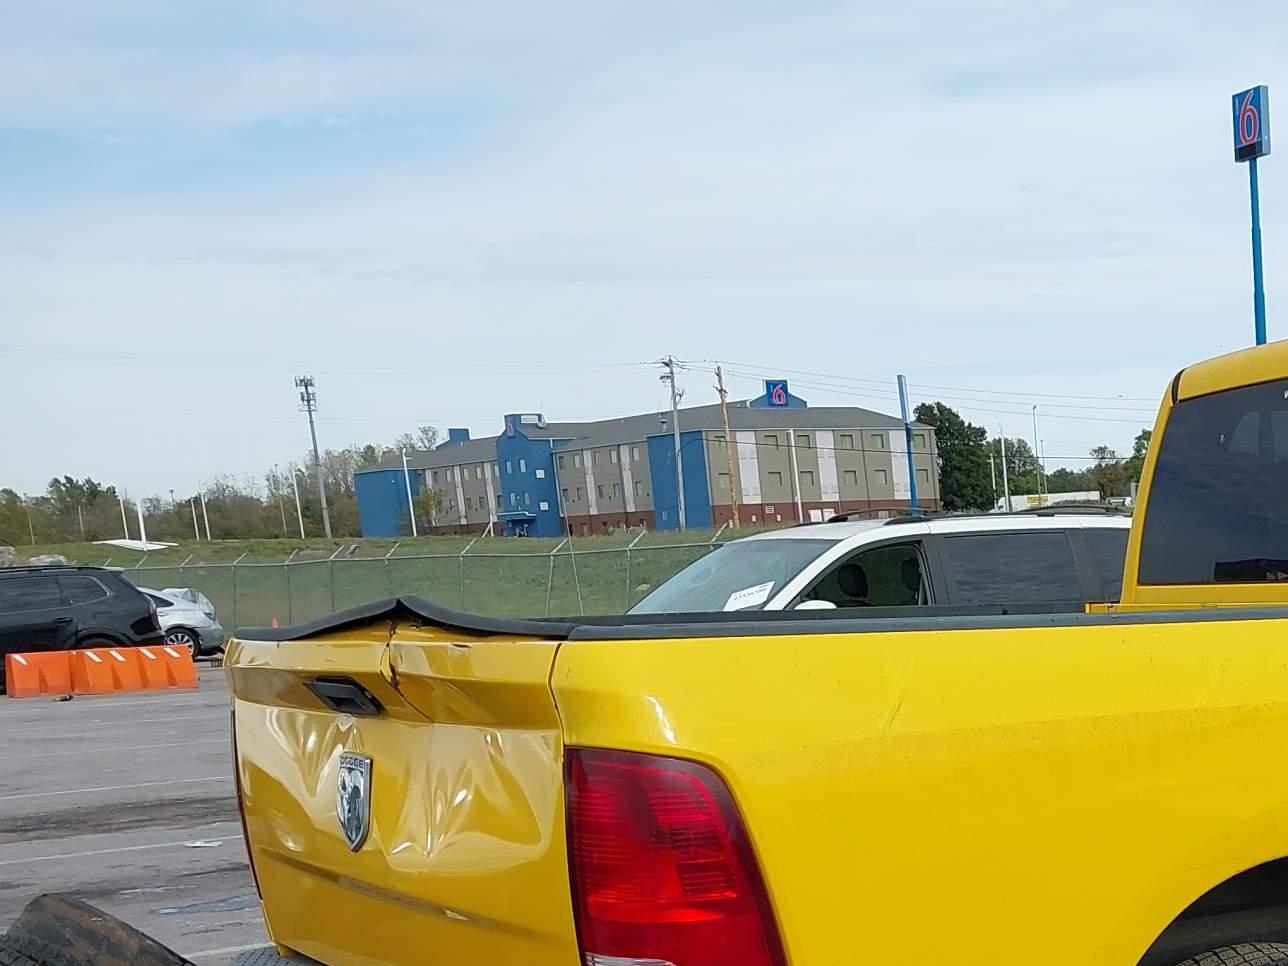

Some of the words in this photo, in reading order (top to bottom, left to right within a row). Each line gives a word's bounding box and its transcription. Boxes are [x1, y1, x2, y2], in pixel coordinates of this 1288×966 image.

[1239, 90, 1259, 145] 6
[772, 383, 786, 405] 6
[340, 756, 364, 768] DODGE
